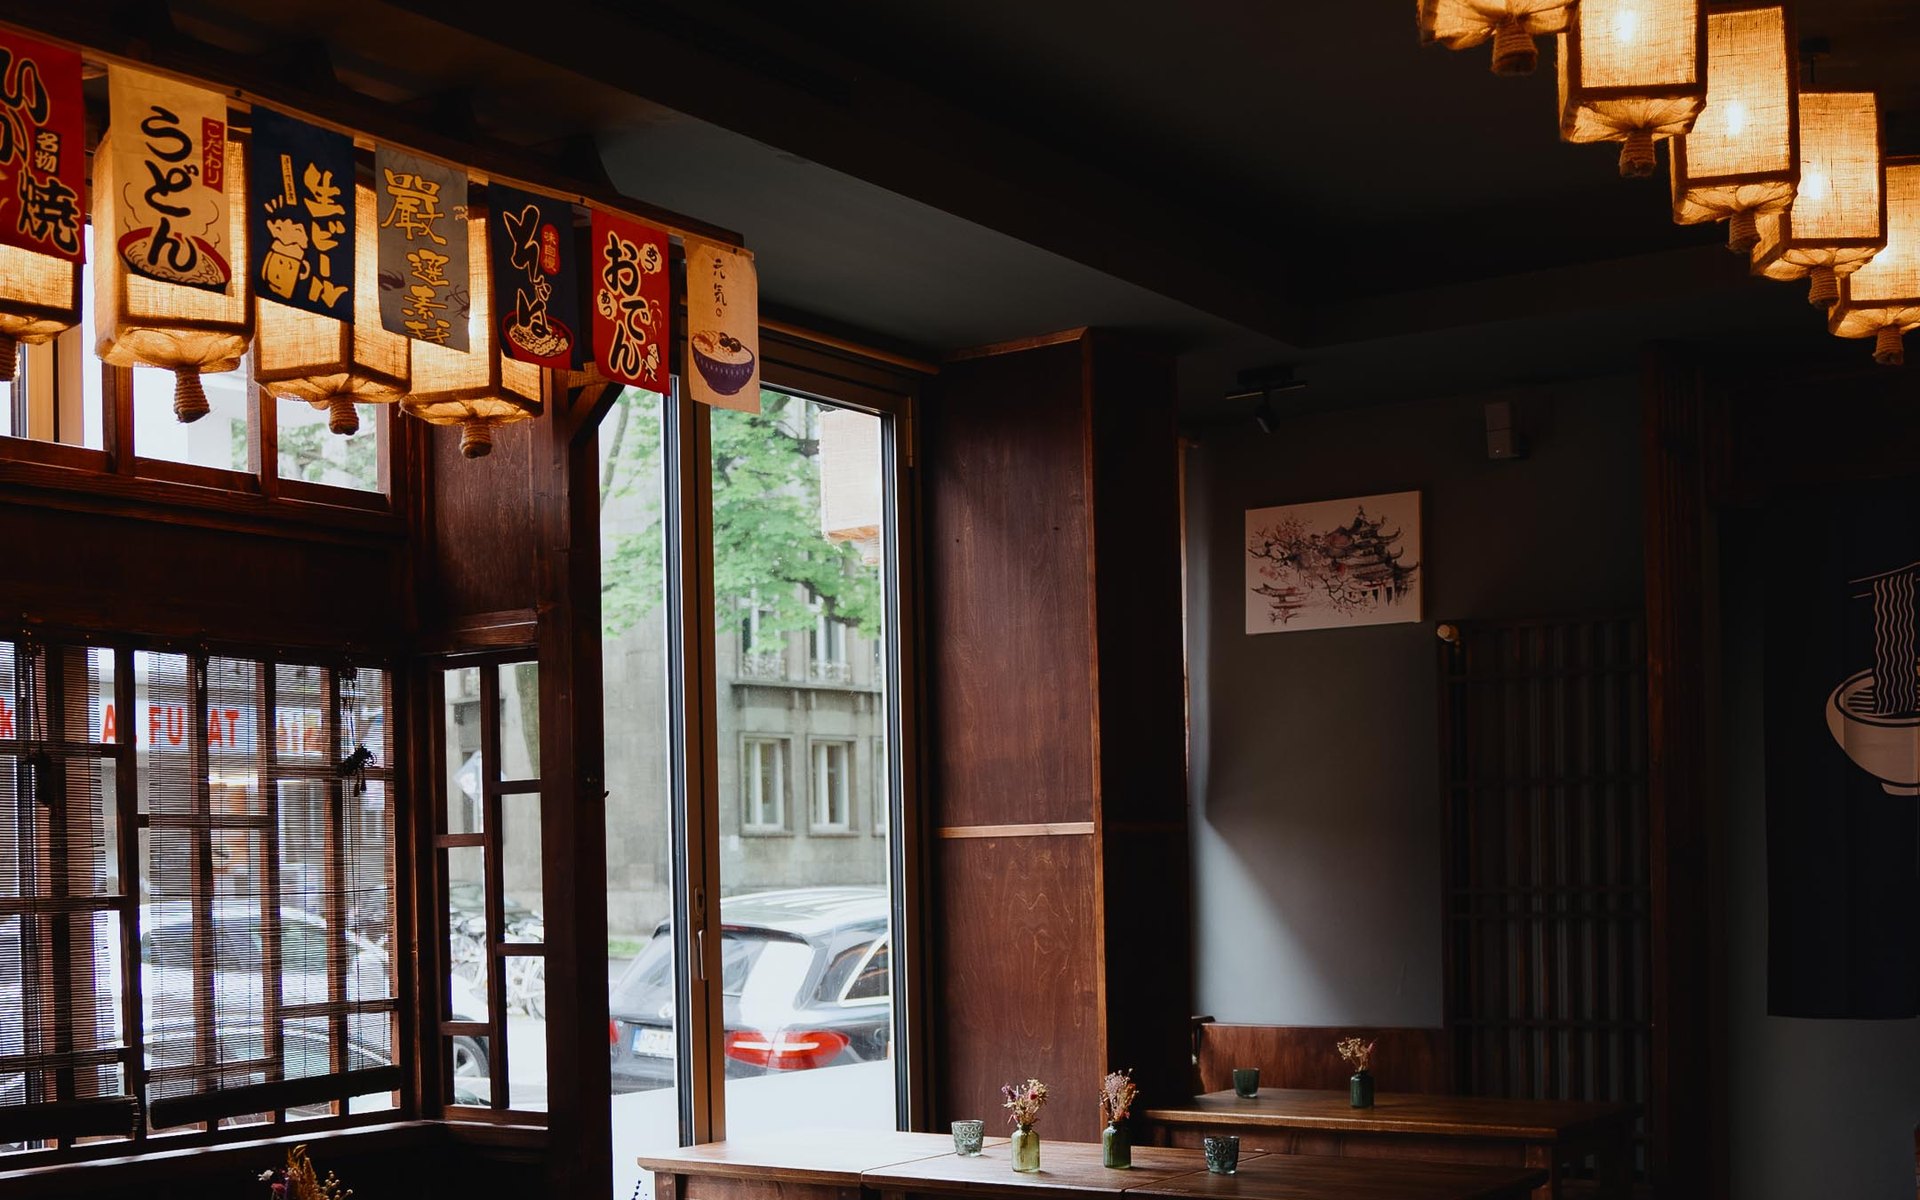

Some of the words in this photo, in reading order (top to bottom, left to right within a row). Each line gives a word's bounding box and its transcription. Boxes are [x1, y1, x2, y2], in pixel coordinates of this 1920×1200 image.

[35, 132, 58, 173] 名物
[140, 105, 200, 272] うどん
[204, 122, 223, 184] こだわり
[303, 162, 349, 309] 生ビール
[601, 291, 613, 317] あつ
[603, 230, 650, 379] おでん
